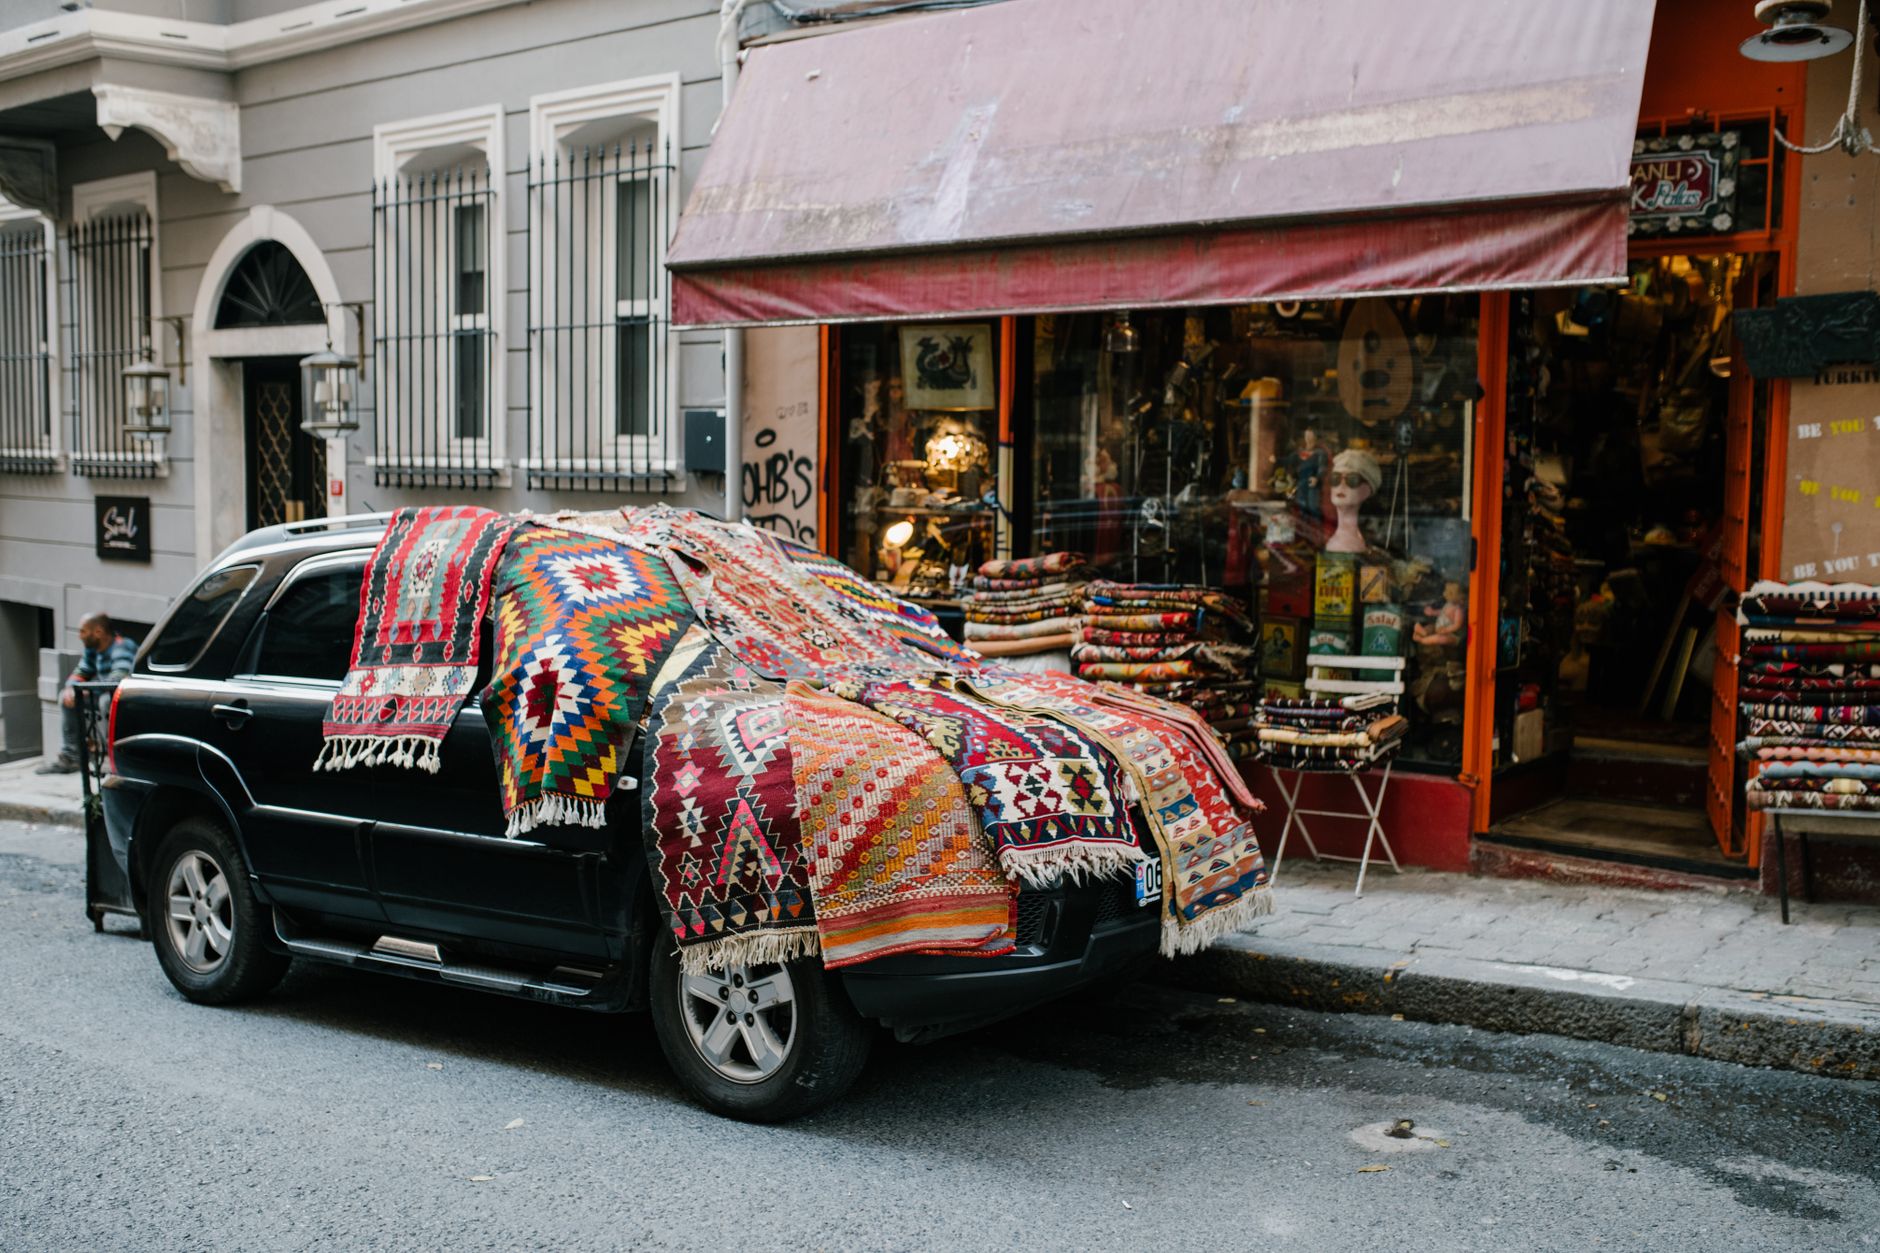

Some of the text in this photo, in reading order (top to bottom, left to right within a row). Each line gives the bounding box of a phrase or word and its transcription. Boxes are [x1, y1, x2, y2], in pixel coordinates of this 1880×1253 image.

[1797, 422, 1823, 439] BE
[1830, 416, 1865, 437] YOU
[1793, 562, 1818, 580] BE
[1823, 555, 1859, 575] YOU
